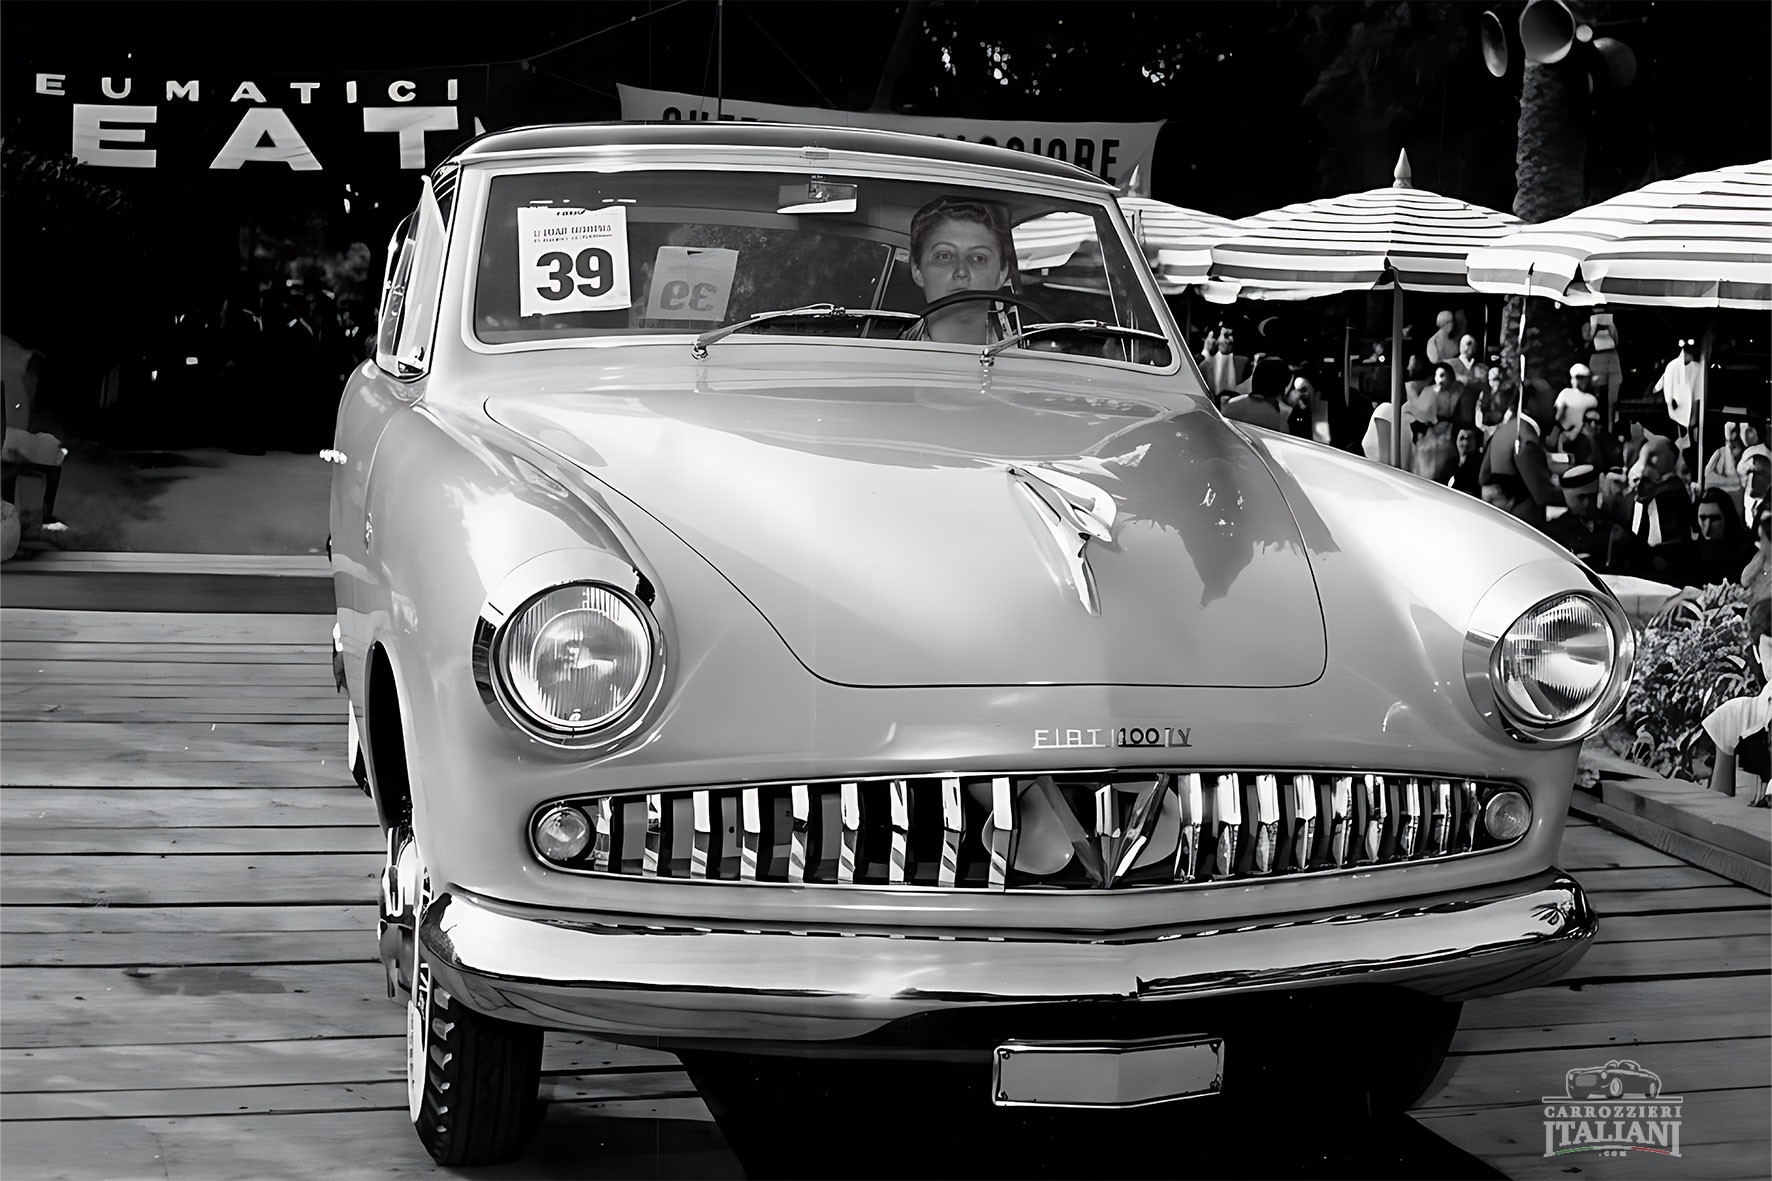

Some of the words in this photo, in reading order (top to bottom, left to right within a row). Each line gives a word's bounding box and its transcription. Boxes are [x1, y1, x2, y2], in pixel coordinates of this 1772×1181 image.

[36, 73, 459, 104] EUMATICI
[536, 247, 614, 301] 39
[1033, 728, 1106, 748] FIAT
